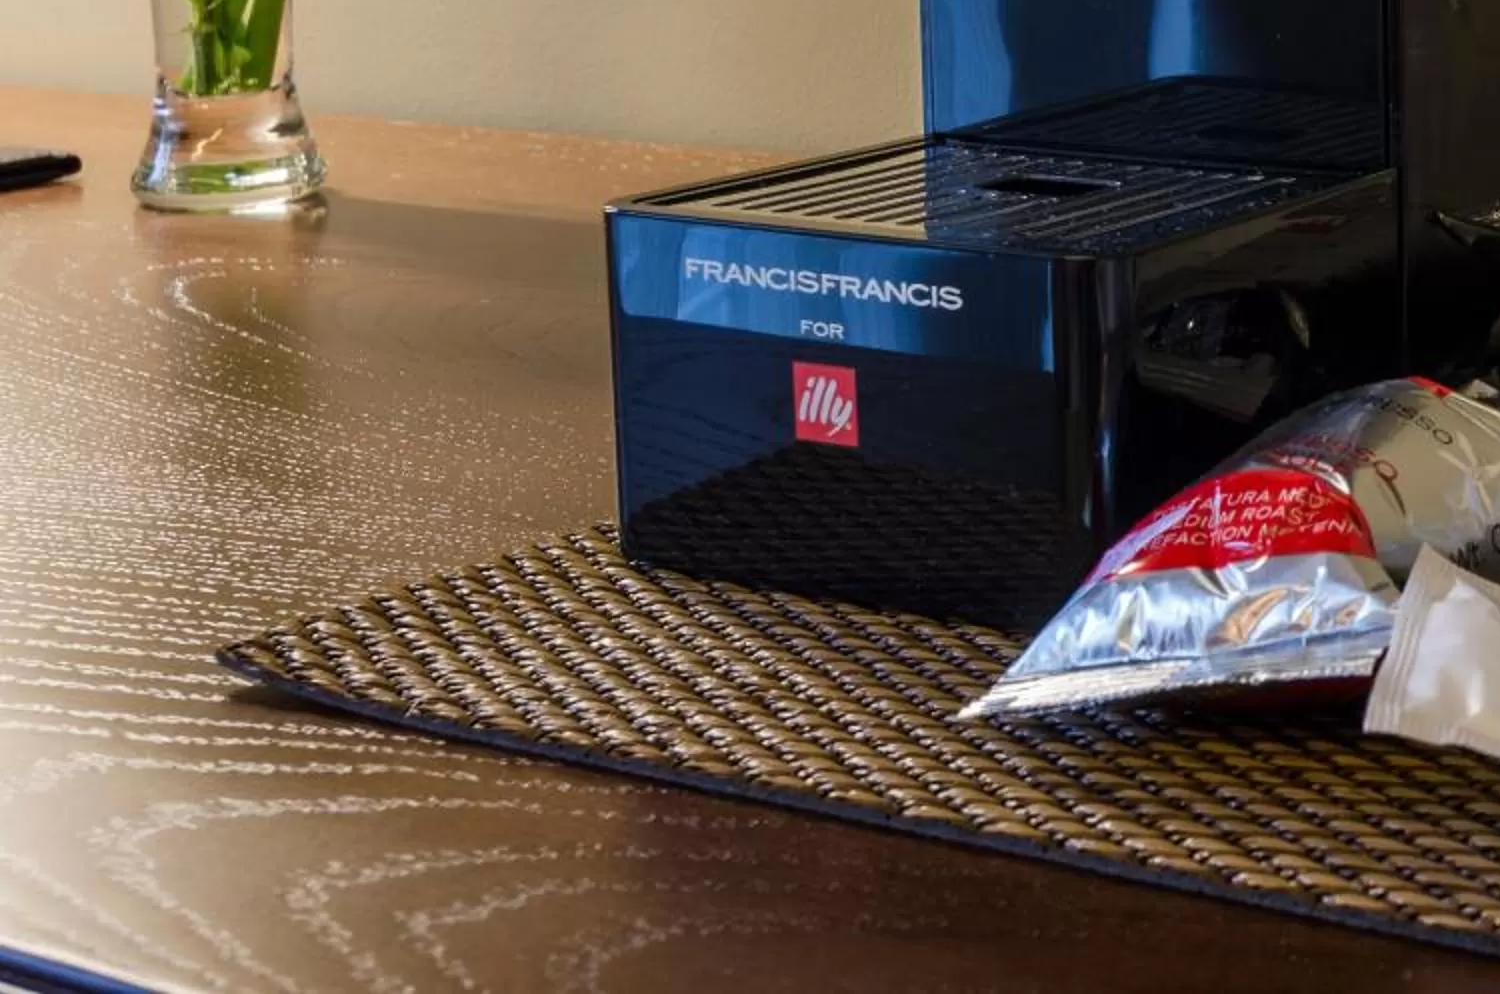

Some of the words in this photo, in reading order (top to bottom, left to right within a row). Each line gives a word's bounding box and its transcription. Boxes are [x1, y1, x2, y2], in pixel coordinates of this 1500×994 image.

[685, 257, 963, 311] FRANCISFRANCIS
[800, 318, 845, 340] FOR
[799, 375, 853, 438] illy
[1241, 506, 1321, 526] ROAST
